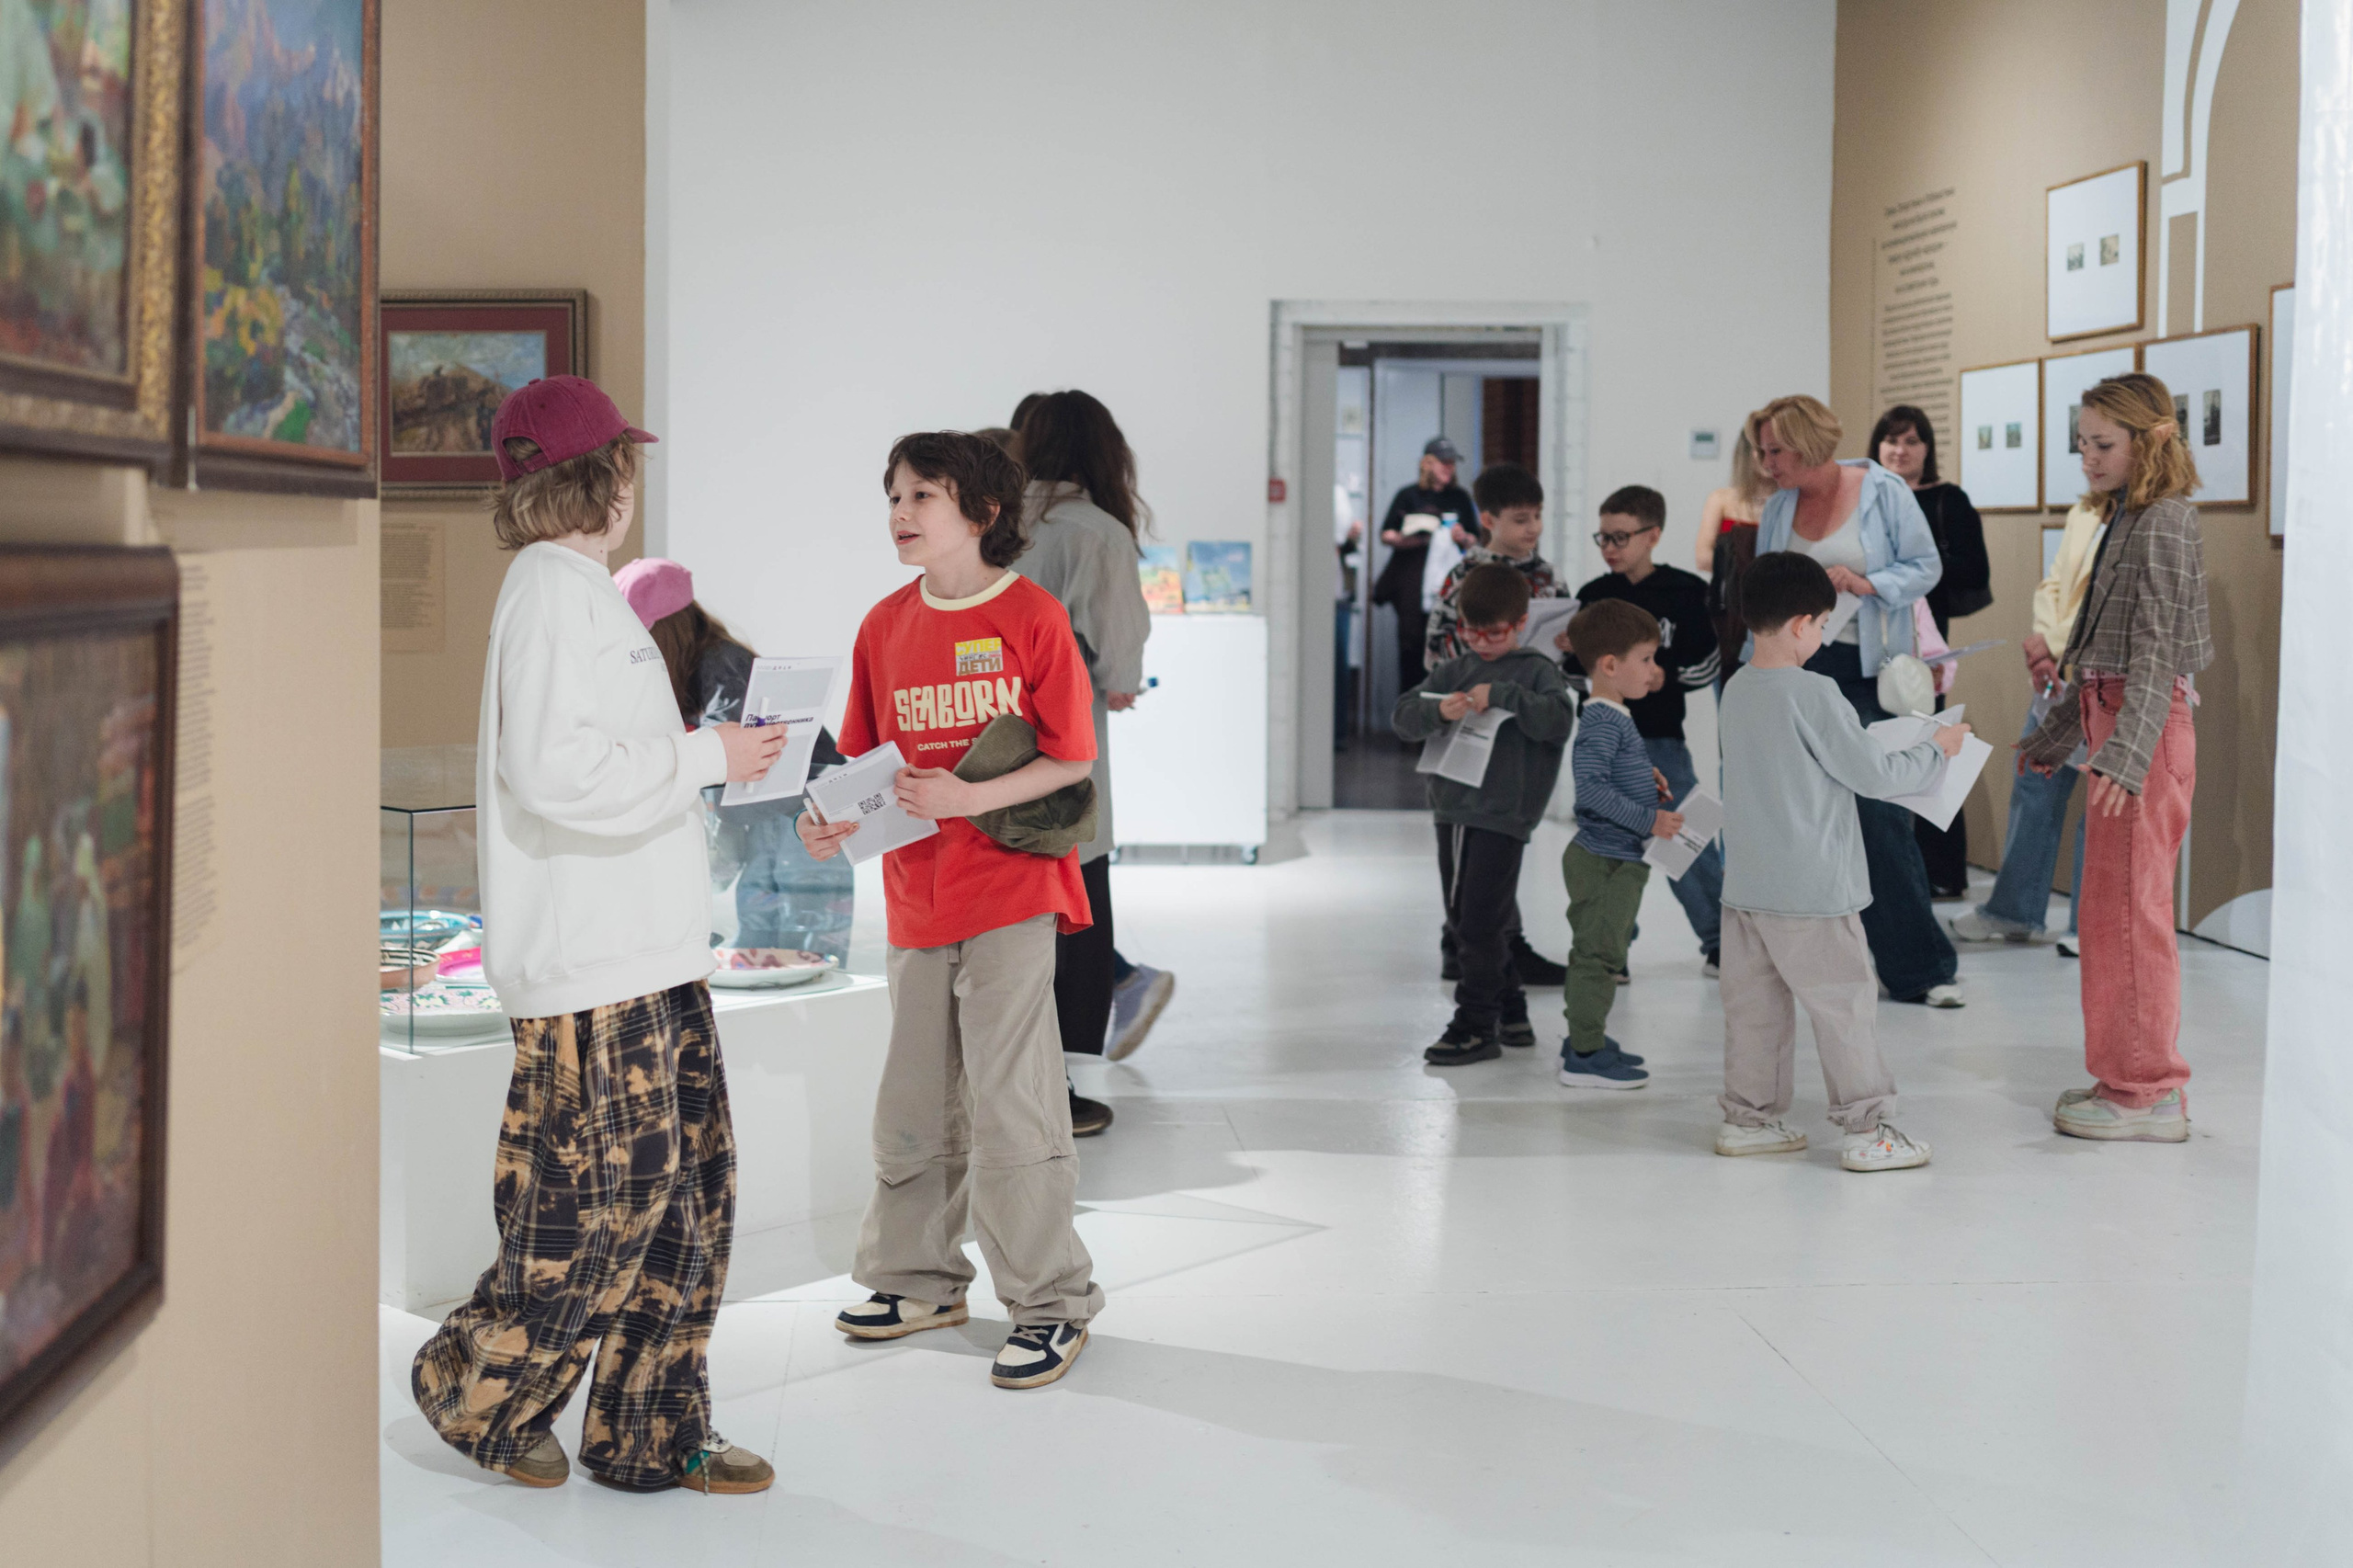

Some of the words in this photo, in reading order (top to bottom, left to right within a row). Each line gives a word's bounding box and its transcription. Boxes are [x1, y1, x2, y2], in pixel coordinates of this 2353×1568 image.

[955, 637, 1002, 656] СУПЕР
[959, 657, 1001, 676] ДЕТИ
[893, 676, 1023, 732] SEABORN
[745, 713, 781, 722] Паорт
[917, 741, 948, 751] CATCH
[949, 738, 970, 748] THE
